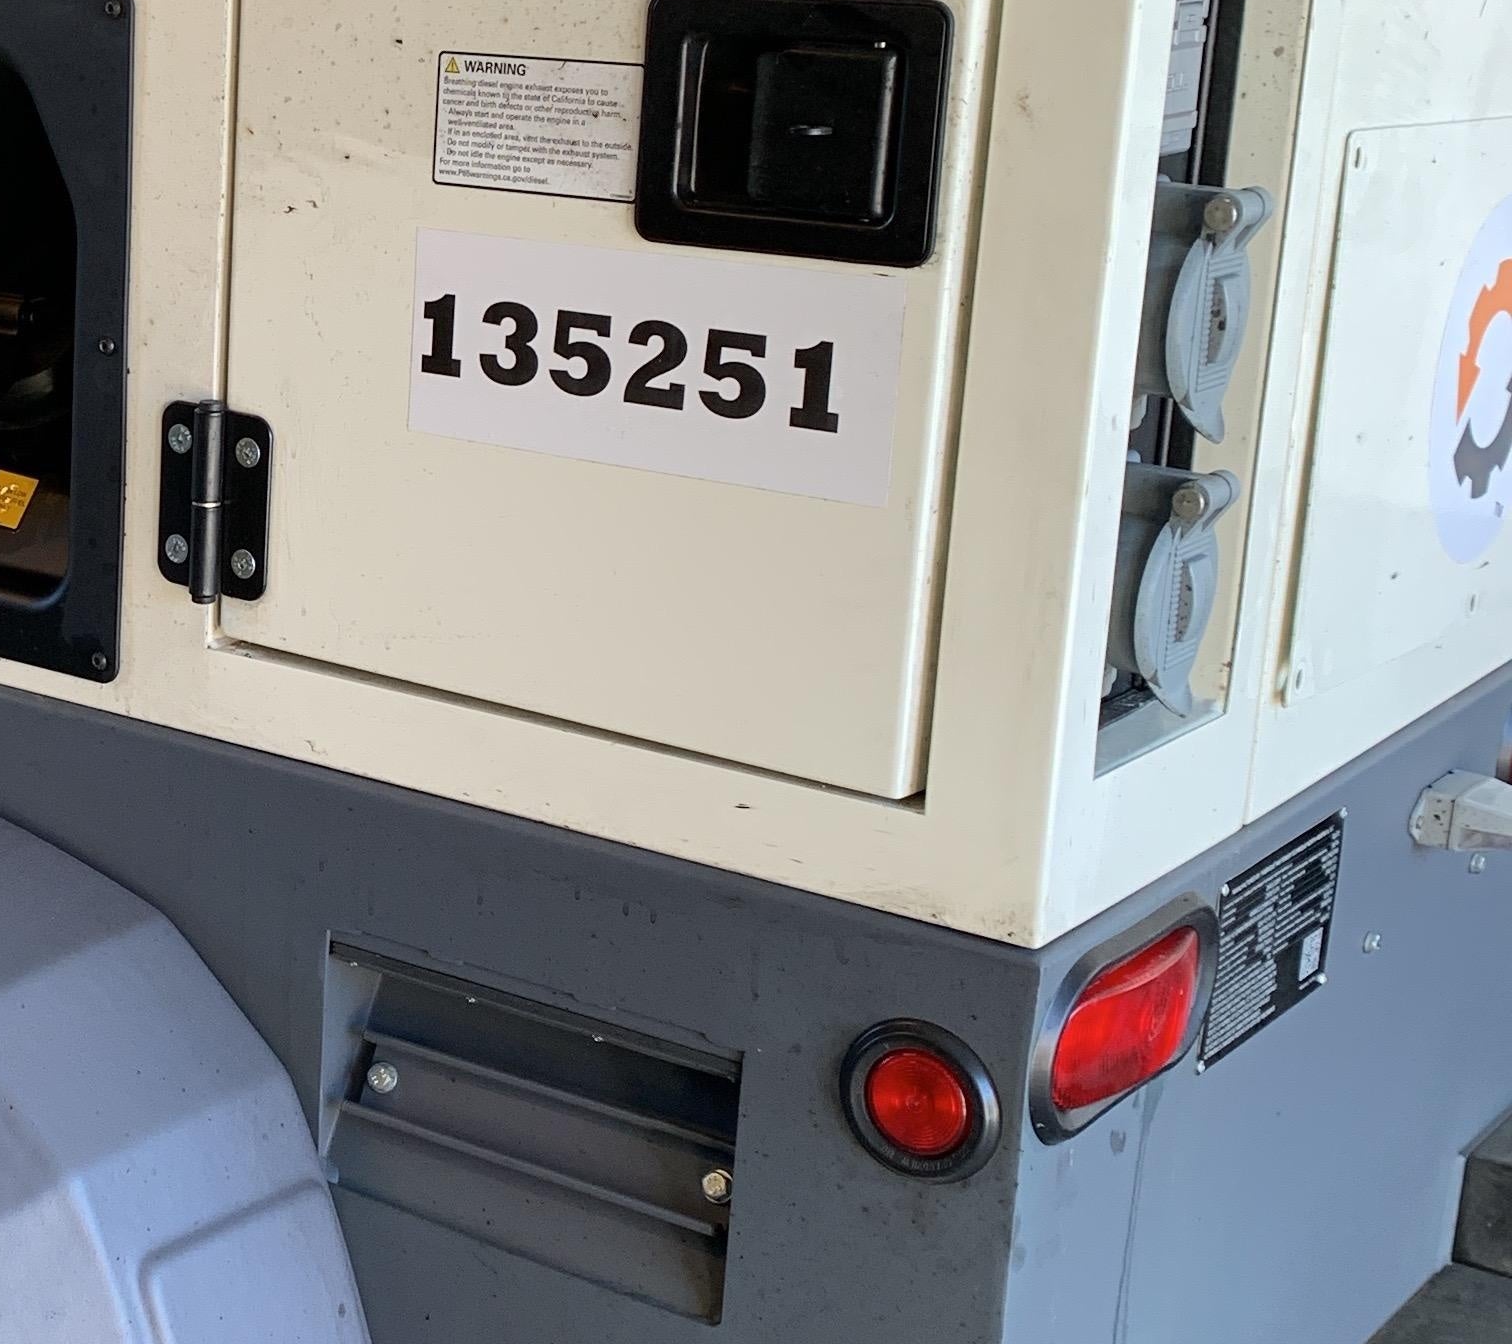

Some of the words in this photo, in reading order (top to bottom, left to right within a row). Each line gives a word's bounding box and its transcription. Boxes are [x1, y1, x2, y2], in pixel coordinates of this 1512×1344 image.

[464, 60, 527, 76] WARNING
[477, 80, 499, 88] diesel
[554, 87, 584, 96] exposes
[585, 88, 599, 96] you
[600, 88, 609, 96] to
[478, 90, 501, 98] known
[551, 95, 586, 105] California
[587, 98, 595, 106] to
[596, 100, 618, 108] cause
[448, 107, 473, 117] Always
[505, 114, 532, 122] operate
[546, 117, 571, 126] engine
[554, 107, 599, 117] reproductive
[453, 128, 461, 136] in
[447, 138, 456, 146] Do
[458, 139, 469, 147] not
[471, 141, 495, 150] modify
[532, 146, 548, 154] with
[548, 147, 560, 155] the
[439, 157, 451, 165] For
[452, 159, 470, 167] more
[471, 160, 511, 171] information
[446, 147, 456, 156] Do
[497, 154, 521, 162] engine
[522, 156, 545, 165] except
[420, 292, 840, 435] 135251
